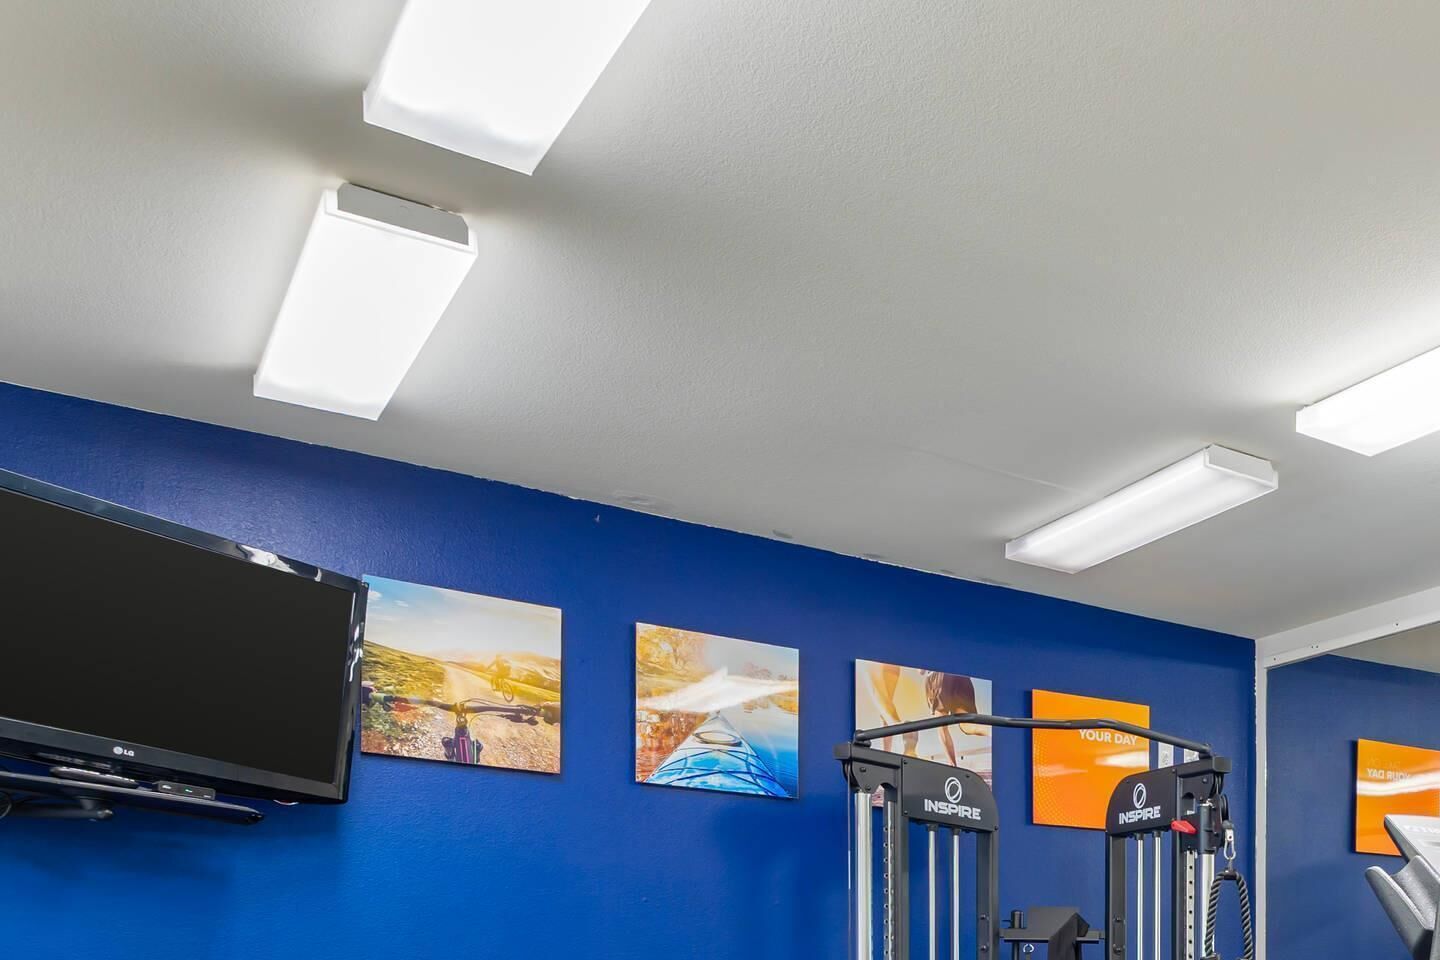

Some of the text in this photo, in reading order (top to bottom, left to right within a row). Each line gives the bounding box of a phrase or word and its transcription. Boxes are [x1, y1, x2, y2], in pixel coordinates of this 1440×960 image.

[1079, 729, 1137, 746] YOUR DAY
[924, 798, 982, 821] INSPIRE
[1118, 805, 1161, 825] INSPIRE
